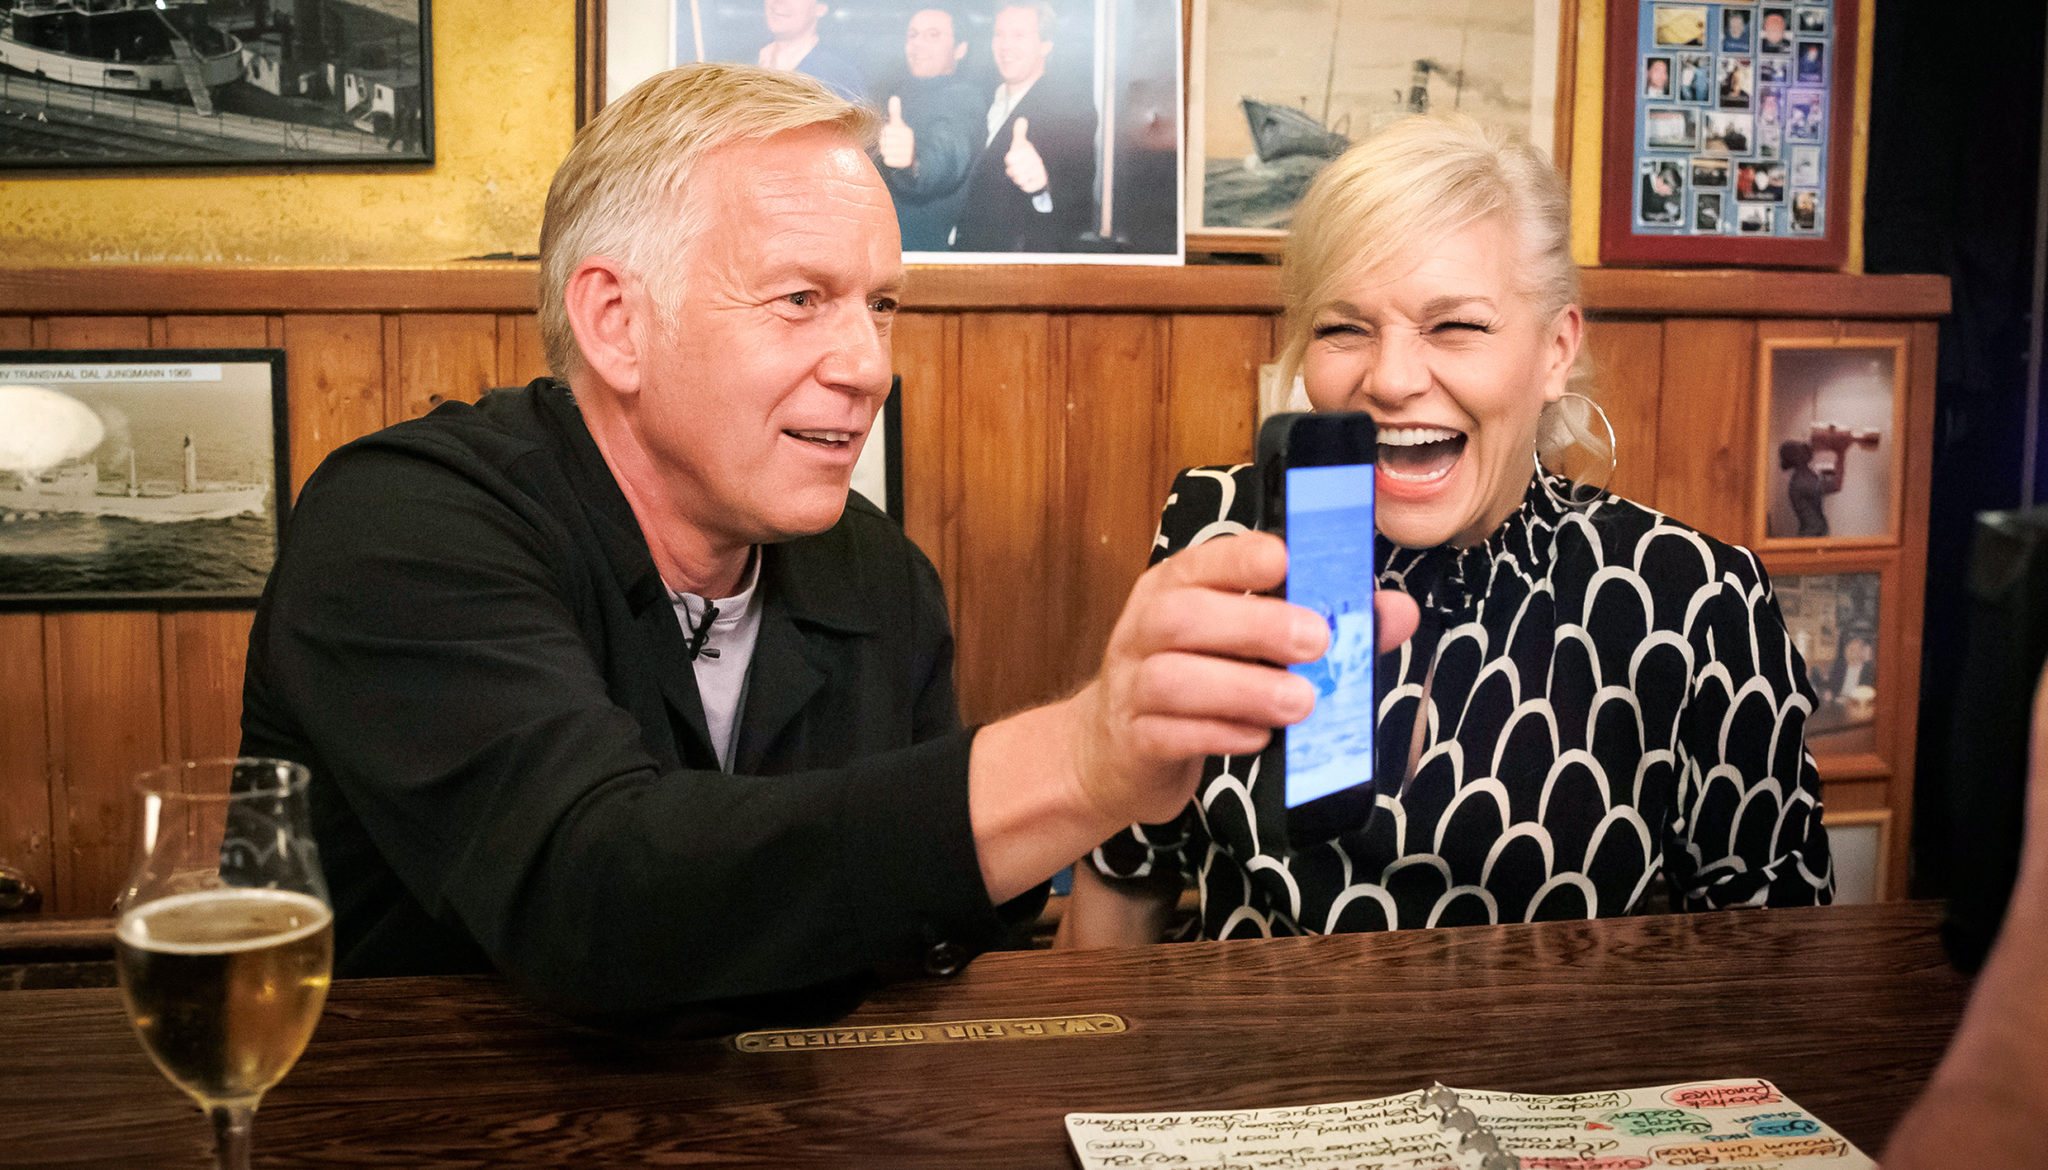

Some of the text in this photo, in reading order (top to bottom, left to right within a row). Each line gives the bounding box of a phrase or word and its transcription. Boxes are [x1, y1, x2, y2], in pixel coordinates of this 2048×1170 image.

[80, 370, 99, 379] DAL
[768, 1026, 924, 1048] OFFIZIERE
[947, 1024, 1002, 1039] FÜR
